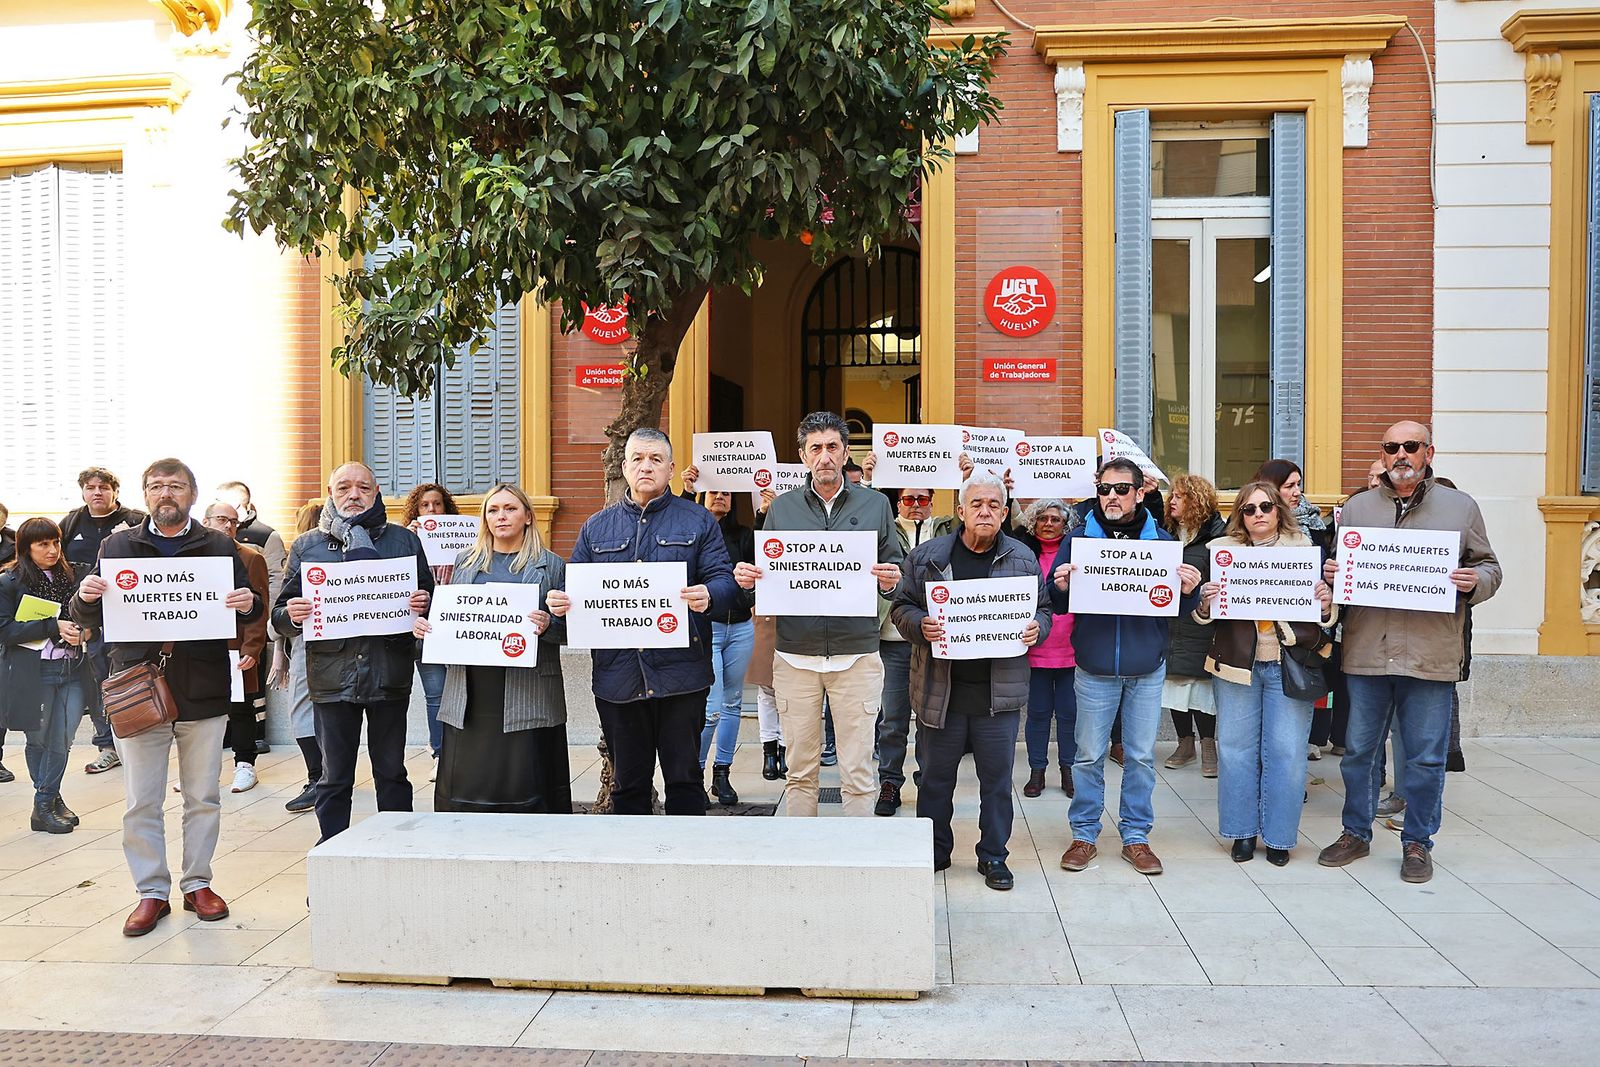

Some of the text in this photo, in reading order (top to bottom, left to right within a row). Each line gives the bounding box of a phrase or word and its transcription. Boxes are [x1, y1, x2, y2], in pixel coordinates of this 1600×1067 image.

[1001, 279, 1038, 296] UGT
[999, 318, 1040, 331] HUELVA
[591, 326, 628, 338] HUELVA
[993, 362, 1047, 370] Unión General
[1000, 371, 1050, 379] Trabajadores
[592, 377, 624, 385] Trabajad
[901, 434, 936, 444] NO MÁS
[971, 434, 988, 442] STOP
[713, 441, 735, 449] STOP
[962, 444, 1009, 454] SINIESTRALID
[702, 453, 767, 462] SINIESTRALIDAD
[886, 451, 952, 459] MUERTES EN EL
[973, 457, 1004, 465] LABORAL
[1018, 458, 1086, 466] SINIESTRALIDAD
[716, 467, 753, 475] LABORAL
[898, 464, 937, 473] TRABAJO
[777, 471, 791, 479] TOP
[786, 543, 844, 553] STOP A LA
[1361, 543, 1450, 556] NO MÁS MUERTES
[1100, 550, 1153, 560] STOP A LA
[769, 561, 862, 571] SINIESTRALIDAD
[1232, 560, 1313, 570] NO MÁS MUERTES
[1356, 562, 1448, 574] MENOS PRECARIEDAD
[1084, 565, 1168, 577] SINIESTRALIDAD
[143, 571, 195, 583] NO MÁS
[327, 572, 410, 587] NO MÁS MUERTES
[1344, 553, 1354, 601] INFORMA
[602, 577, 650, 589] NO MÁS
[789, 580, 842, 589] LABORAL
[1101, 583, 1148, 593] LABORAL
[1356, 580, 1446, 595] MÁS PREVENCIÓN
[123, 591, 219, 603] MUERTES EN EL
[324, 591, 411, 604] MENOS PRECARIEDAD
[1152, 588, 1171, 597] UGT
[1220, 571, 1228, 616] INFORMA
[456, 595, 508, 606] STOP A LA
[584, 598, 672, 609] MUERTES EN EL
[950, 593, 1031, 605] NO MÁS MUERTES
[1231, 596, 1312, 606] MÁS PREVENCIÓN
[142, 610, 198, 621] TRABAJO
[313, 590, 323, 637] INFORMA
[327, 608, 410, 623] MÁS PREVENCIÓN
[440, 612, 523, 624] SINIESTRALIDAD
[948, 612, 1031, 622] MENOS PRECARIEDAD
[601, 617, 653, 627] TRABAJO
[456, 630, 503, 641] LABORAL
[950, 633, 971, 643] MÁS
[505, 636, 524, 646] UGT
